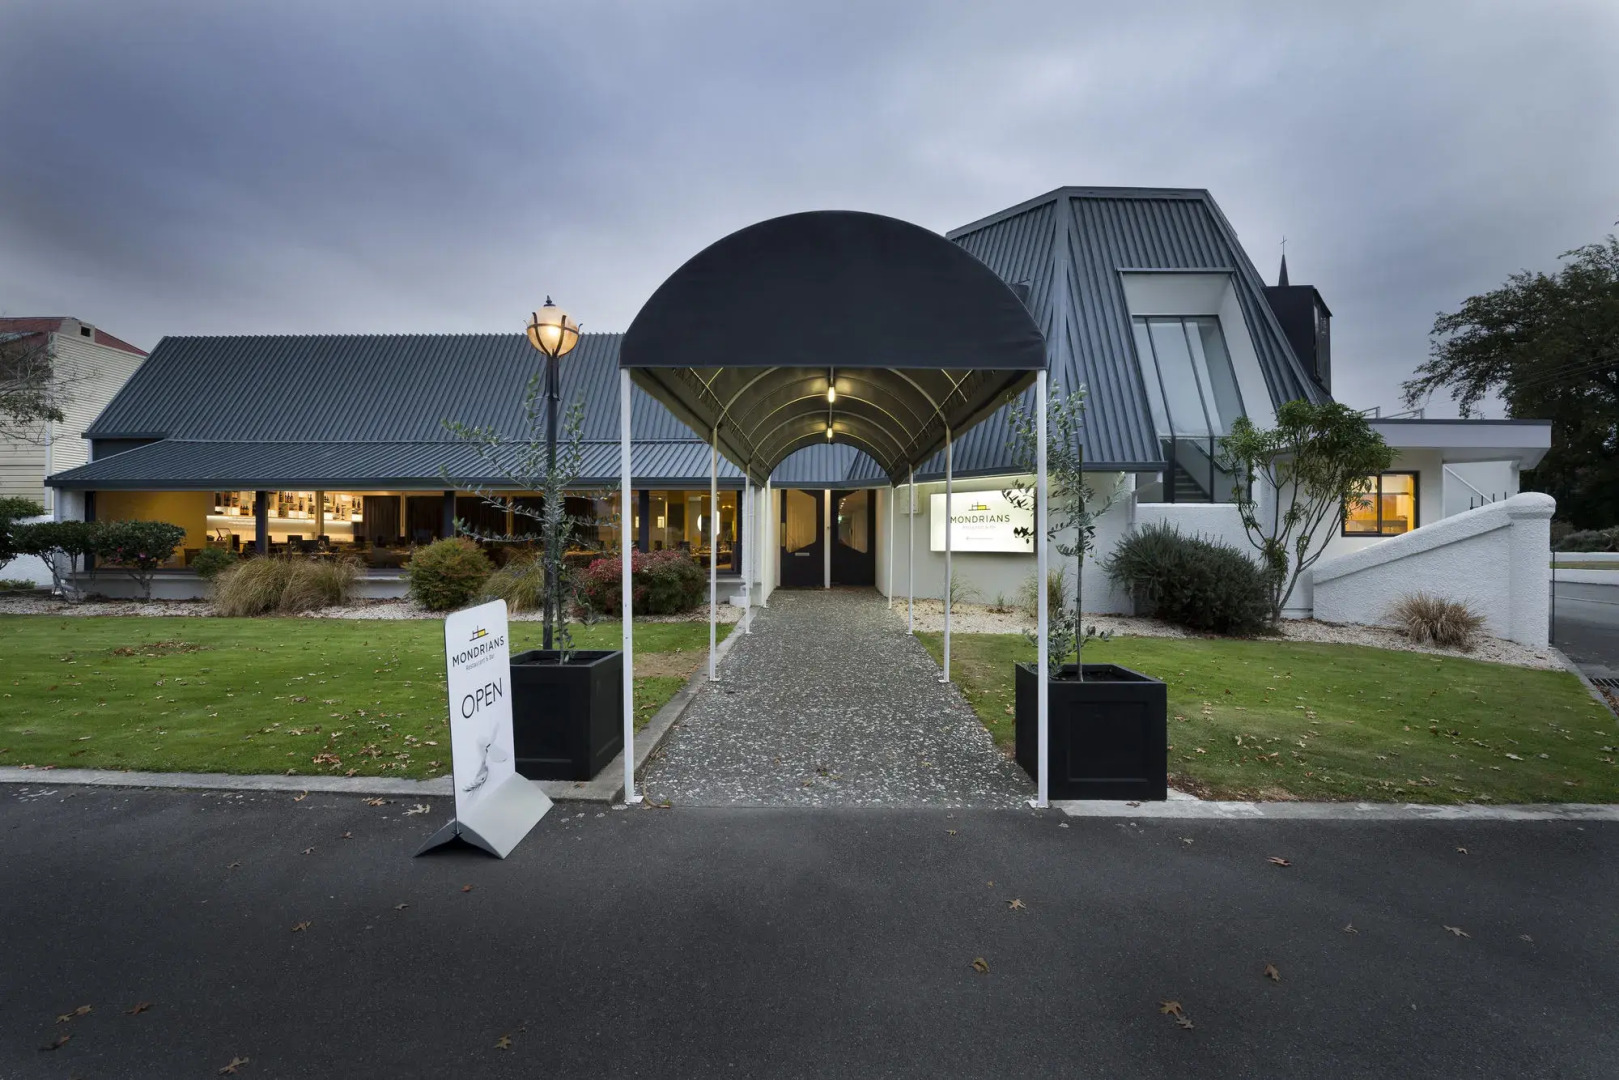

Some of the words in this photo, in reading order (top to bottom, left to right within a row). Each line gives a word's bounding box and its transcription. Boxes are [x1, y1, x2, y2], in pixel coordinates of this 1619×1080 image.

[950, 515, 1010, 523] MONDRIANS
[452, 636, 504, 667] MONDRIANS
[462, 678, 502, 718] OPEN
